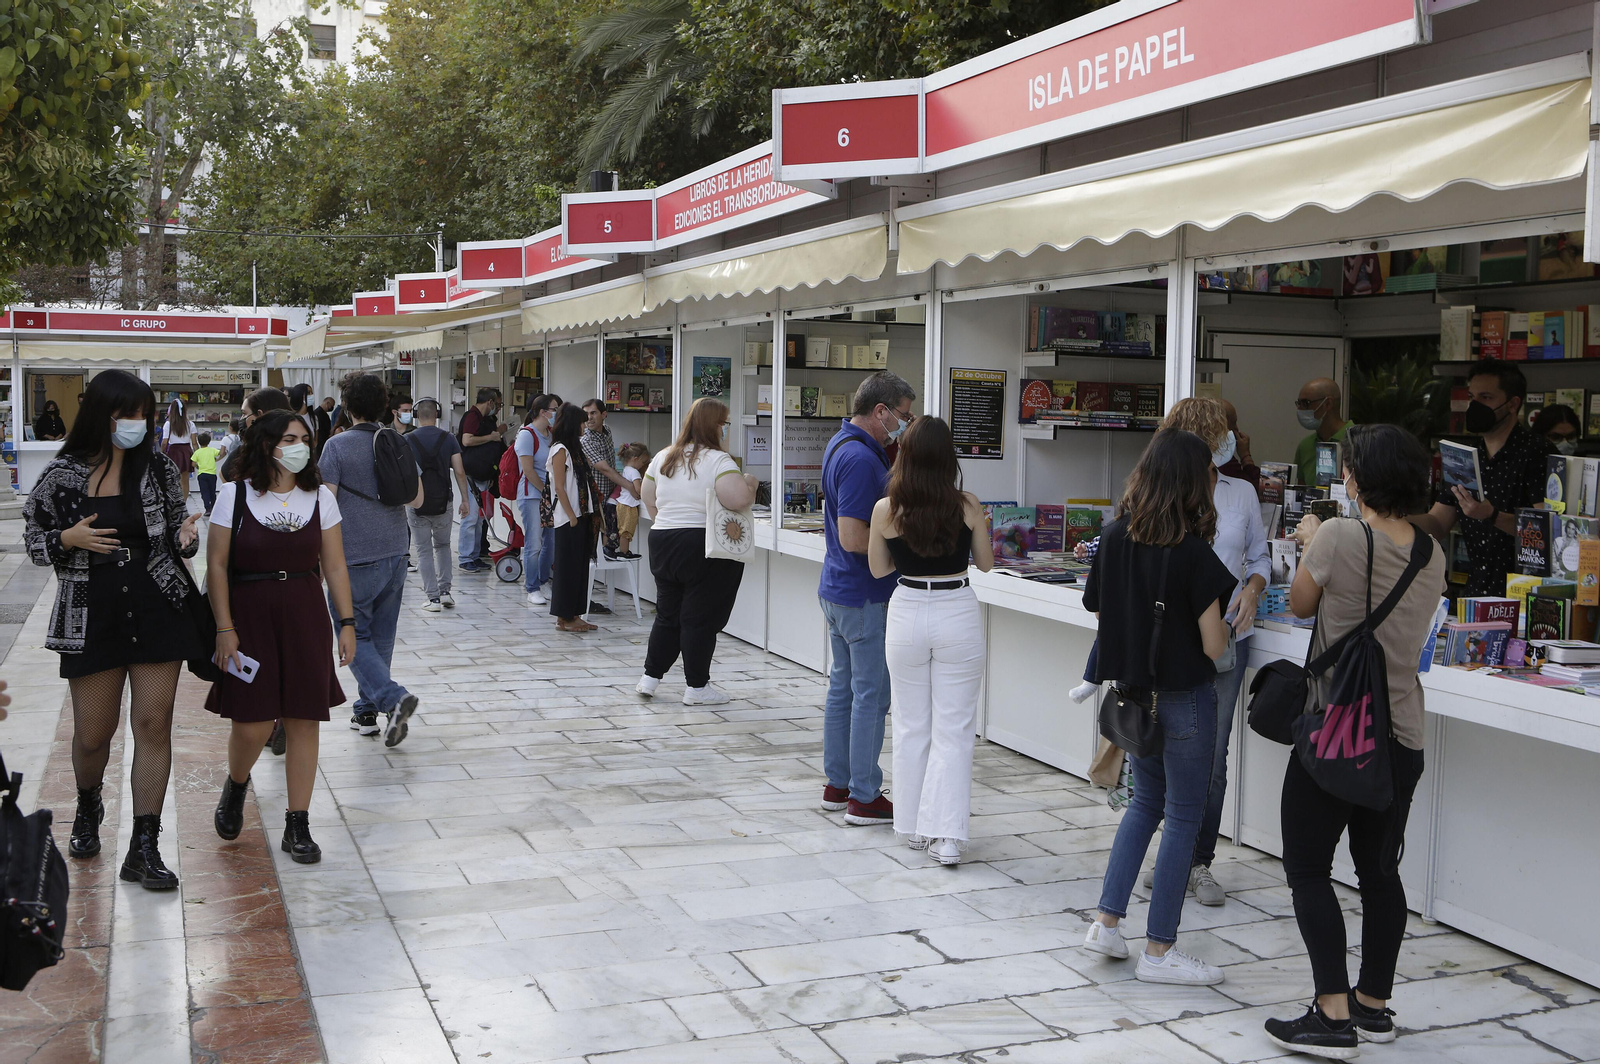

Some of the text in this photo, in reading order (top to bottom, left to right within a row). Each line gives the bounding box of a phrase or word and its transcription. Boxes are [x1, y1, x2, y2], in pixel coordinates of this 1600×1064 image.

[1028, 26, 1195, 111] ISLA DE PAPEL
[836, 127, 850, 148] 6
[689, 178, 717, 202] LIBROS
[717, 172, 729, 192] DE
[730, 168, 742, 188] LA
[674, 181, 800, 230] EDICIONES EL TRANSBORDAD
[603, 220, 612, 233] 5
[550, 247, 557, 263] EL
[488, 262, 495, 272] 4
[420, 290, 425, 298] 3
[120, 319, 167, 329] IC GRUPO
[1527, 521, 1533, 529] A
[1516, 529, 1543, 540] FUEGO
[1521, 539, 1545, 550] LENTO
[1521, 547, 1540, 557] PAULA
[1517, 554, 1545, 565] HAWKINS
[41, 835, 52, 871] HILFIGER
